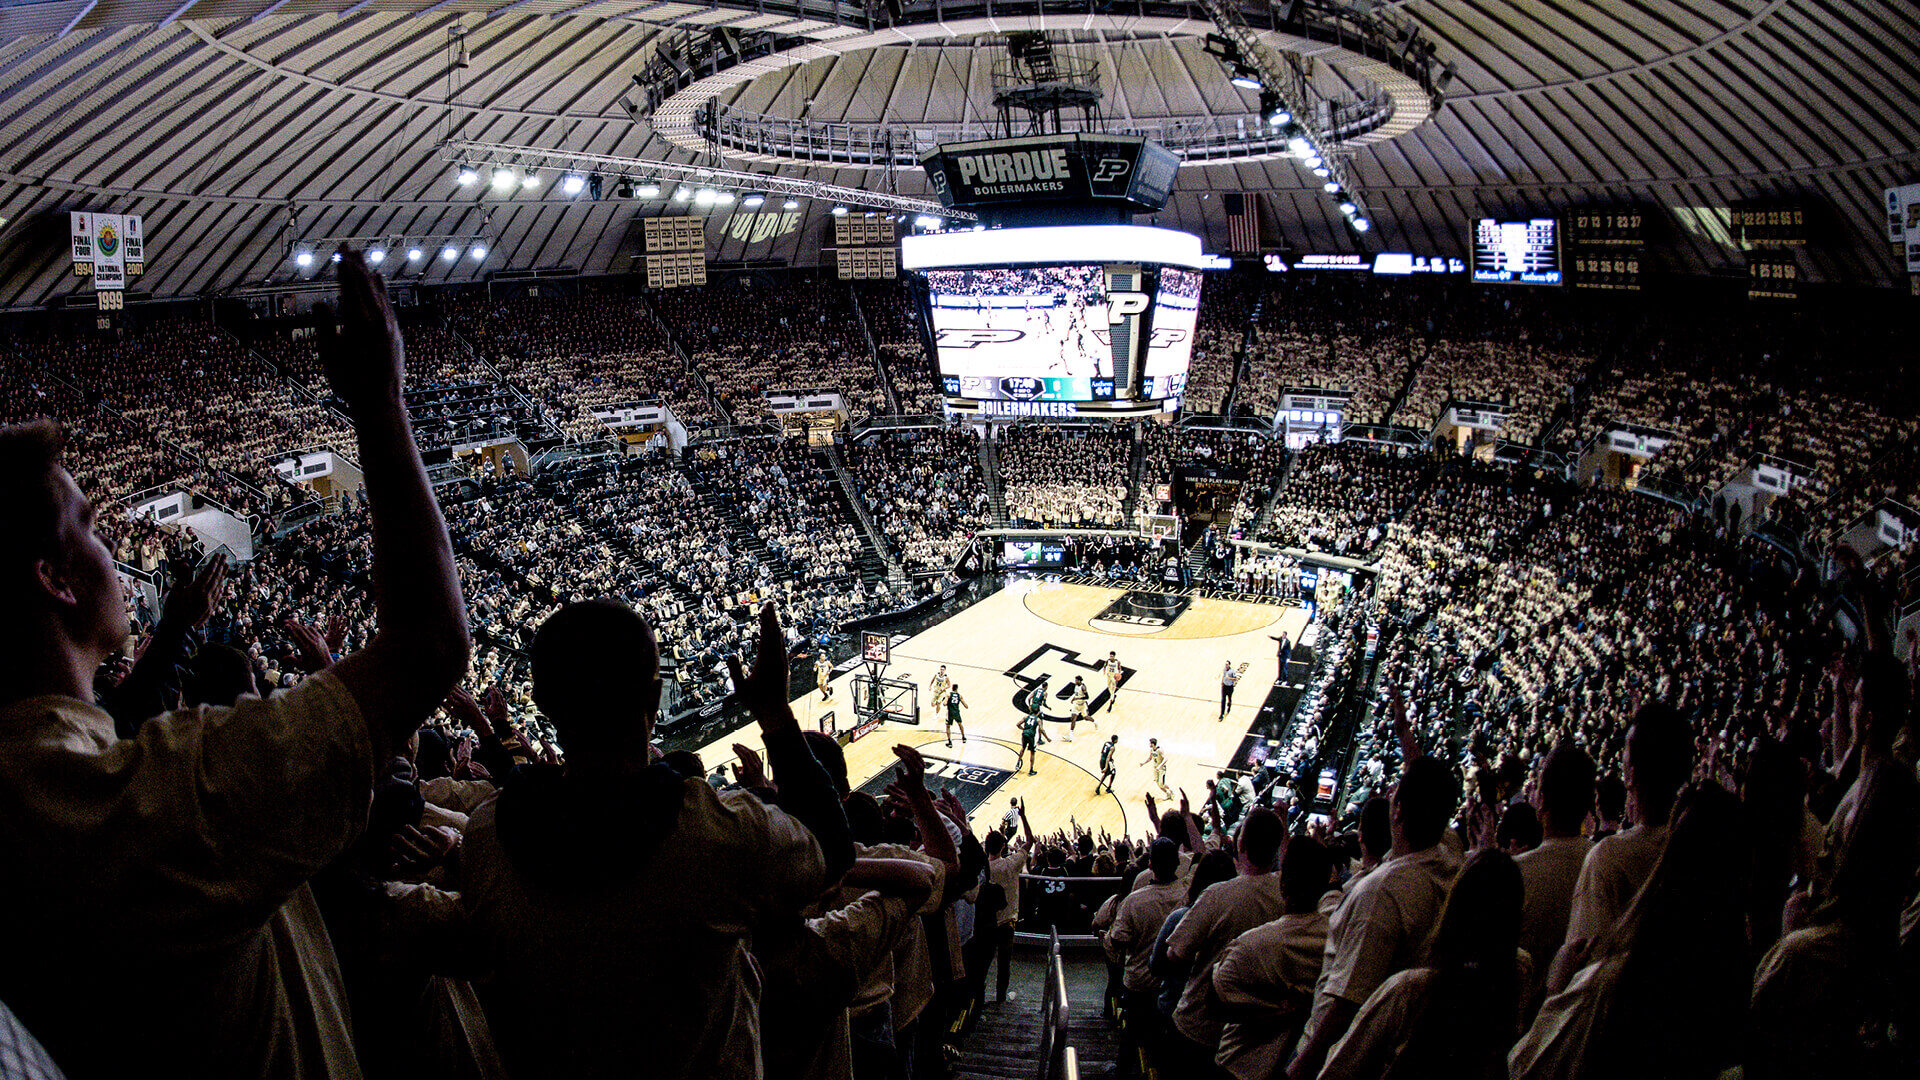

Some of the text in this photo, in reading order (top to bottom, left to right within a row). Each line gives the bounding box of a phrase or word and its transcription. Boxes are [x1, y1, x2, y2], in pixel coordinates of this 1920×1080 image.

[957, 148, 1070, 186] PURDUE
[974, 181, 1064, 196] BOILERMAKERS
[719, 212, 802, 244] PURDUE
[73, 236, 91, 246] FINAL
[125, 238, 141, 247] FINAL
[75, 246, 91, 256] FOUR
[126, 247, 141, 257] FOUR
[74, 263, 94, 276] 1994
[97, 265, 120, 273] NATIONAL
[126, 264, 143, 275] 2001
[97, 292, 123, 310] 1999
[1106, 292, 1150, 325] P
[977, 401, 1077, 417] BOILERMAKERS
